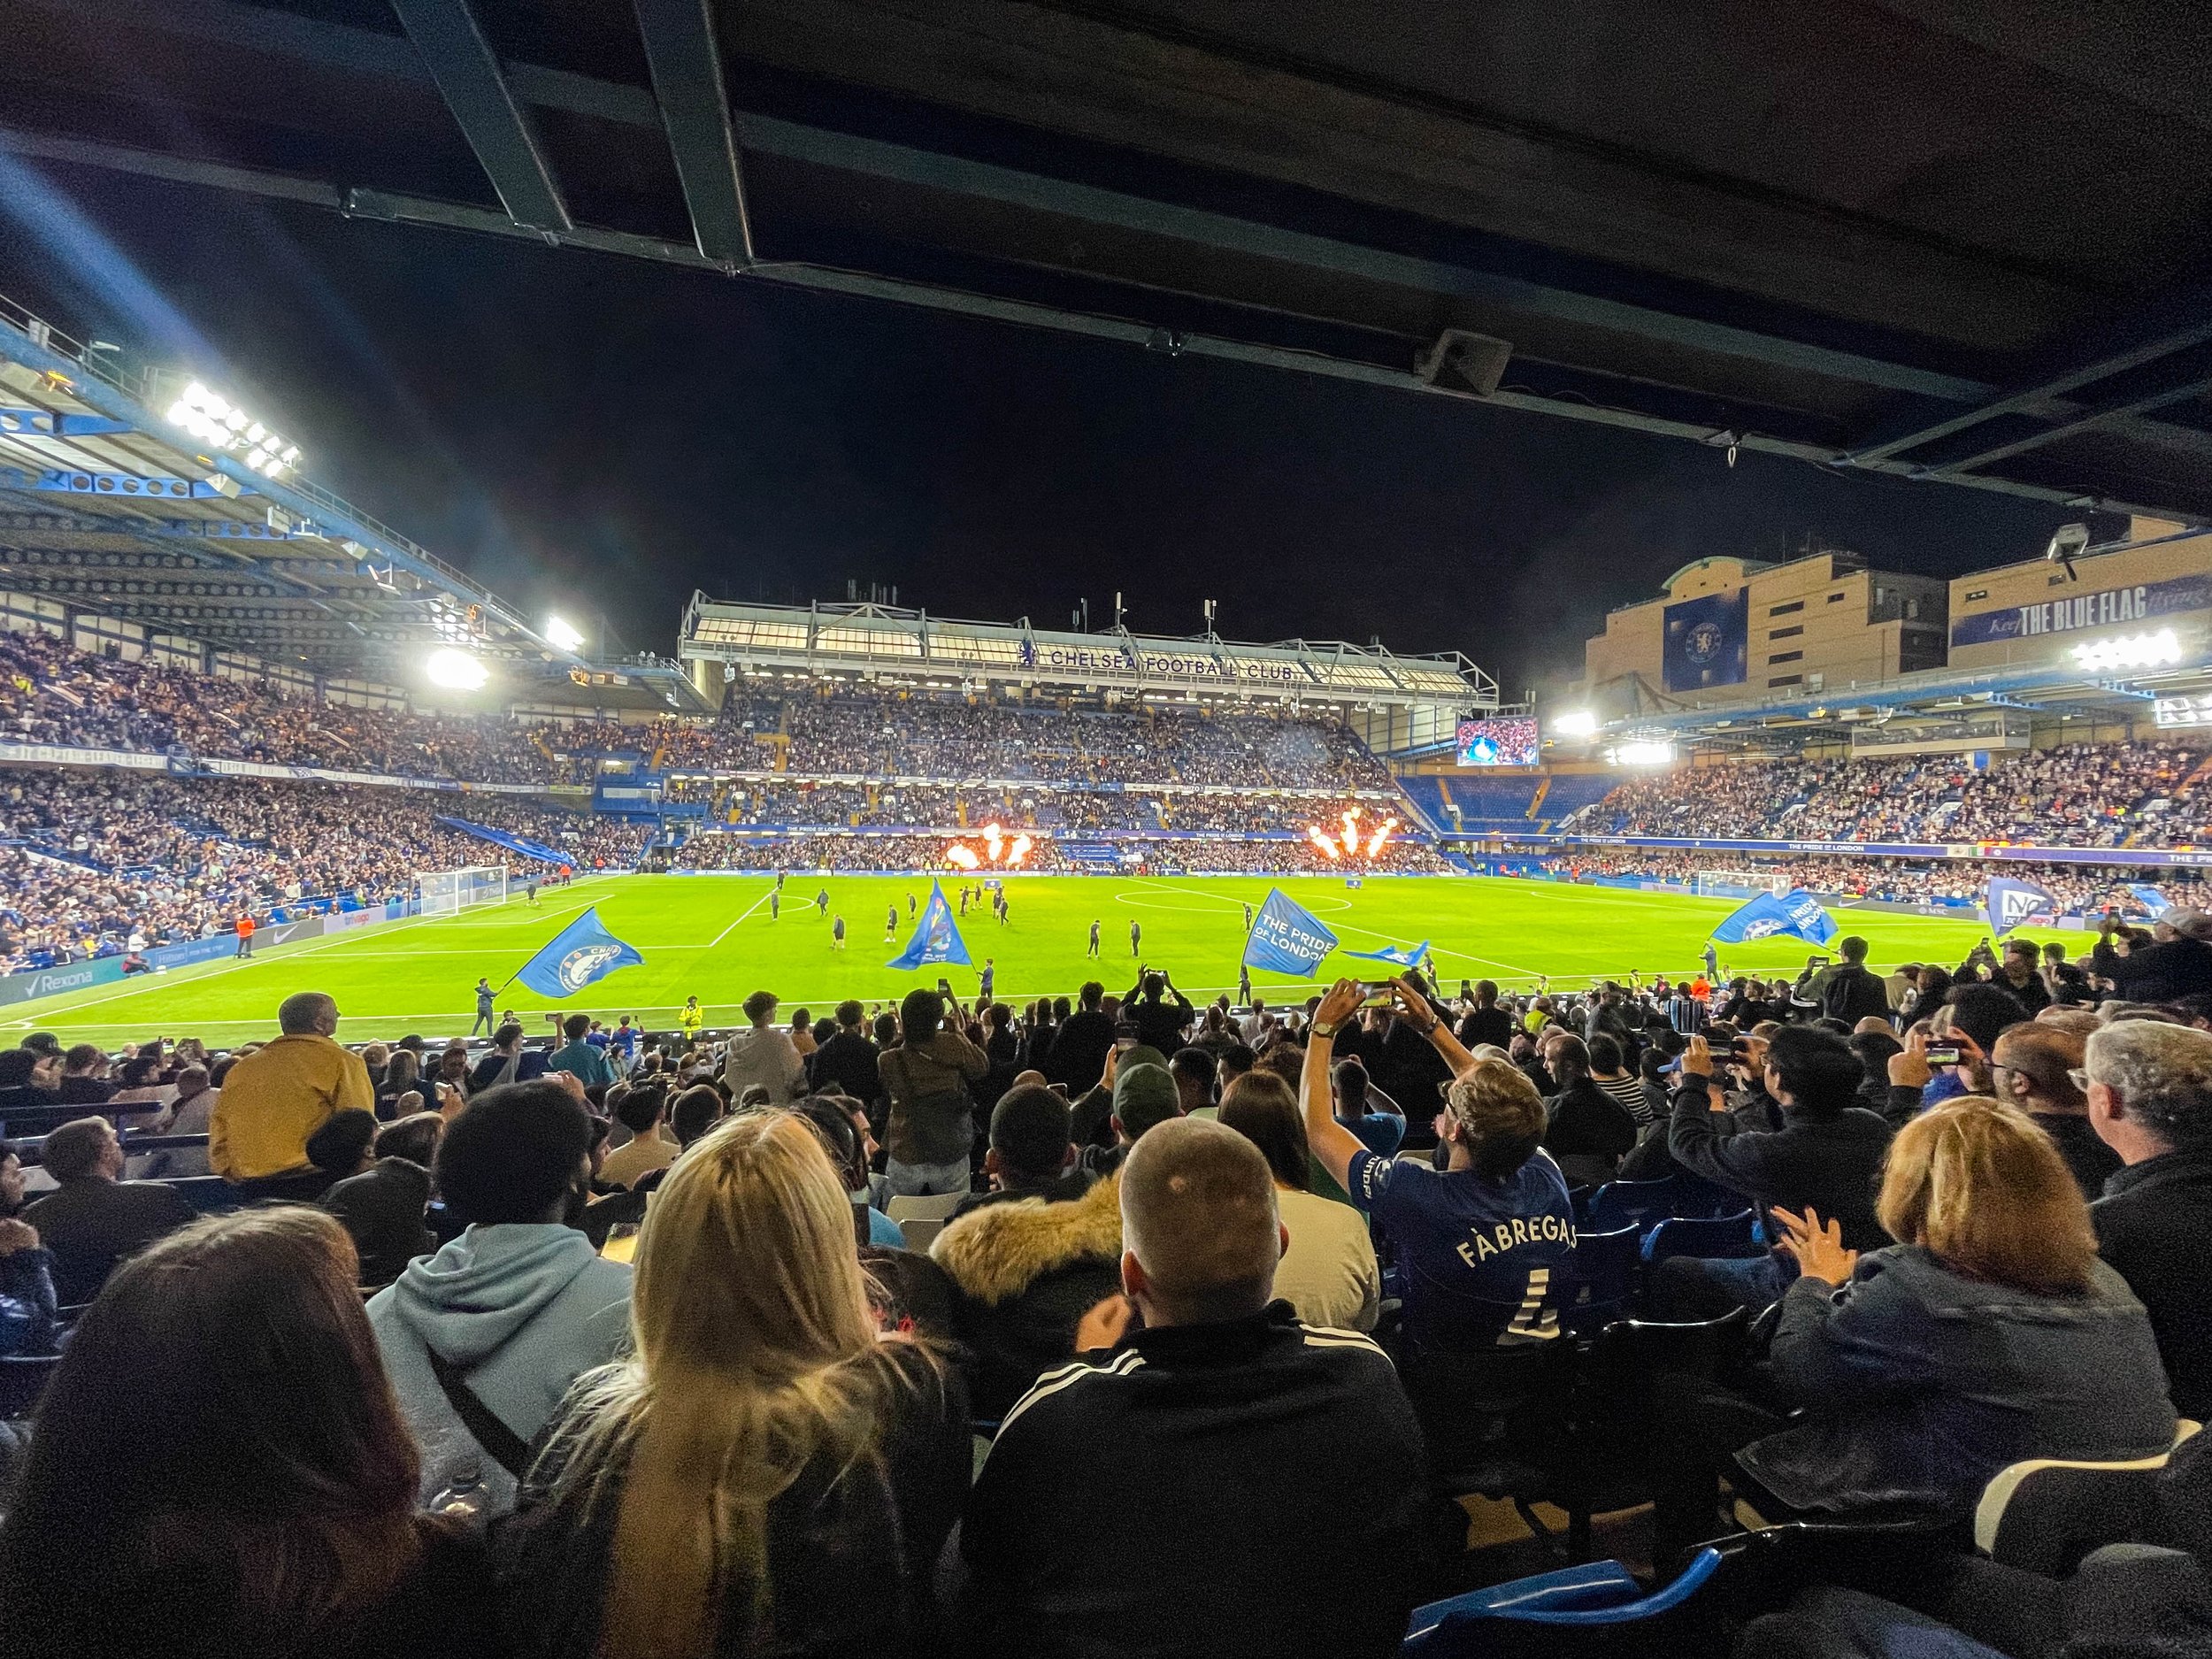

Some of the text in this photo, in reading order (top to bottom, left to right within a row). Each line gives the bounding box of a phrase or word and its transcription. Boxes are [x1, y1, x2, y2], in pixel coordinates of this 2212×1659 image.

[2019, 603, 2050, 636] THE
[2053, 595, 2095, 631] BLUE
[2100, 586, 2147, 624] FLAG
[1050, 650, 1293, 680] CHELSEA FOOTBALL CLUB
[2168, 854, 2194, 863] THE
[1929, 907, 1948, 916] MSC
[1256, 927, 1270, 937] OF
[1263, 914, 1334, 952] THE PRIDE
[42, 971, 93, 992] Rexona
